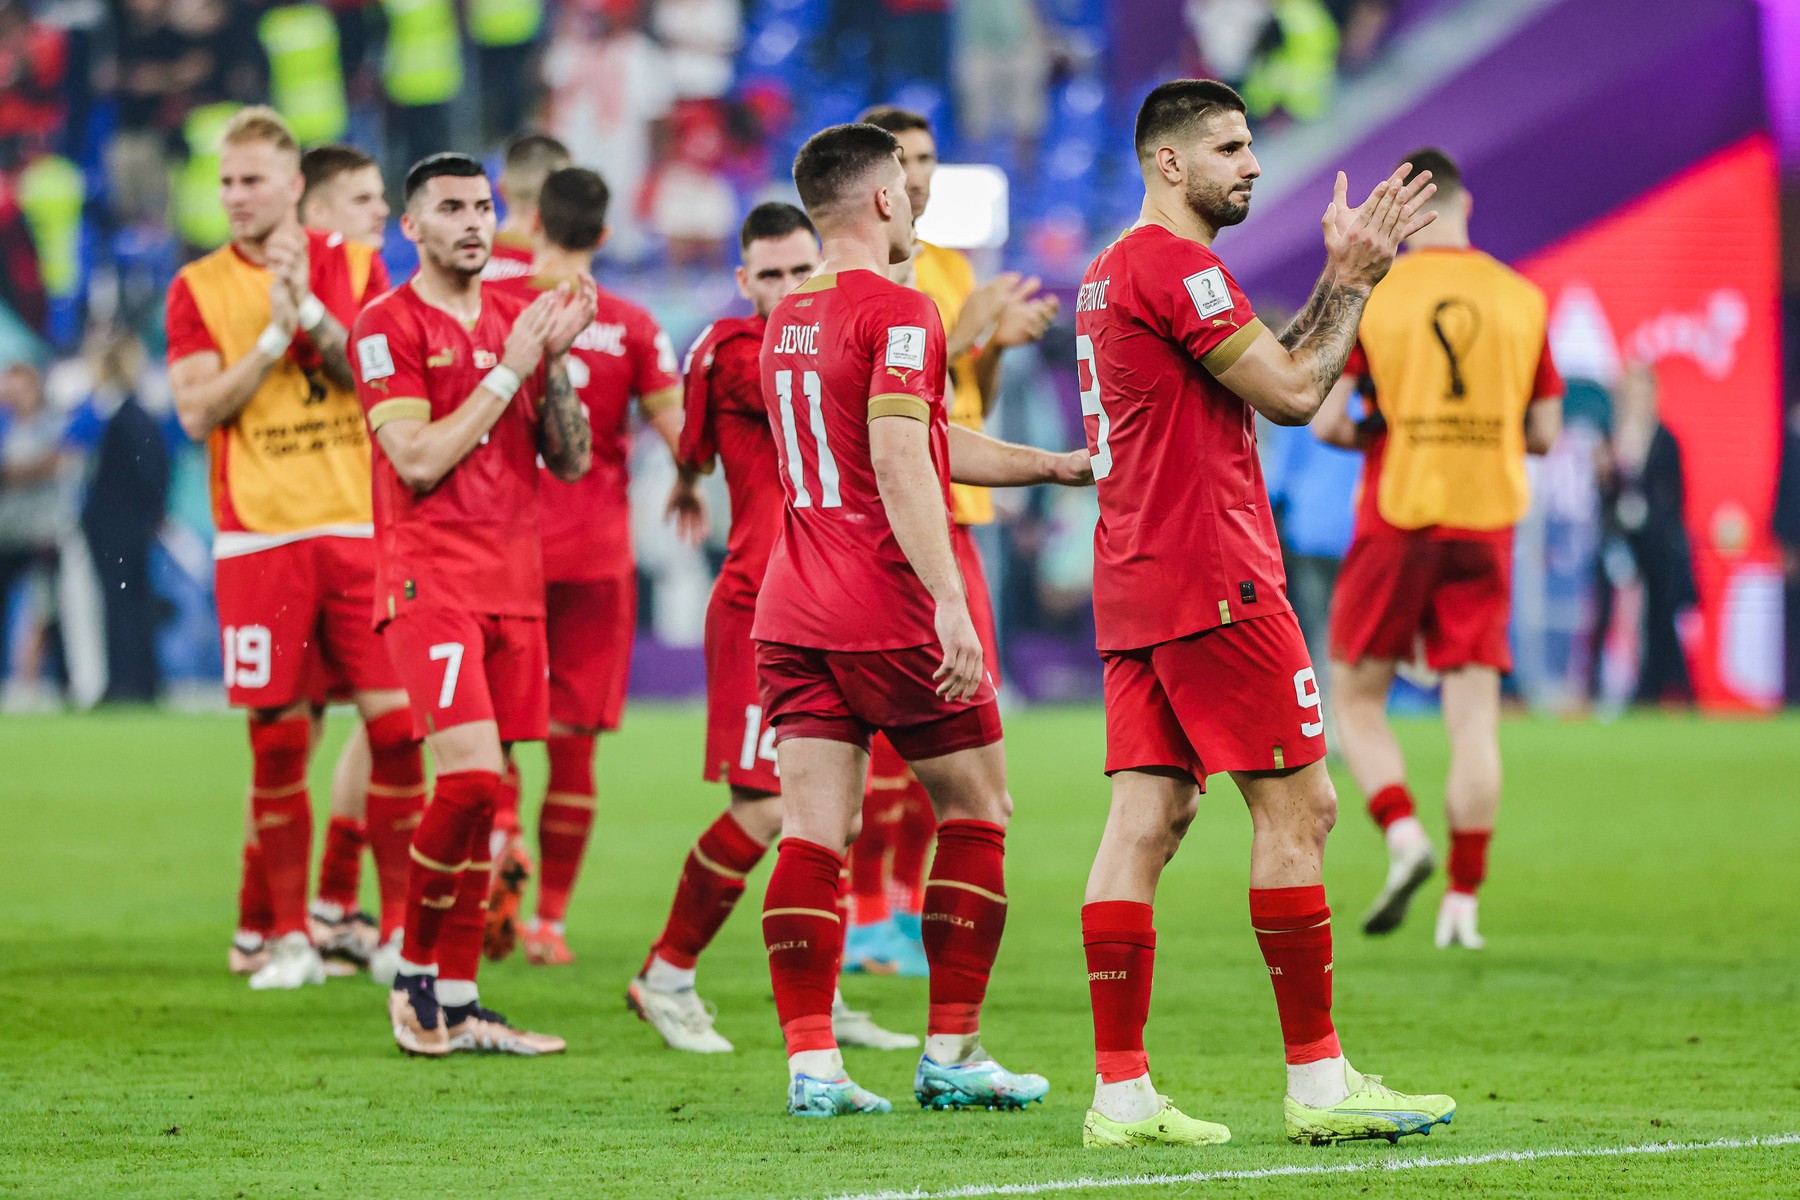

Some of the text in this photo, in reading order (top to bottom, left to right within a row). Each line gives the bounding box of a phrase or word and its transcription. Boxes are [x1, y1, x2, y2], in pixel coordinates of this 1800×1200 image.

[774, 322, 820, 355] JOVIĆ
[775, 370, 842, 508] 11
[224, 625, 272, 688] 19
[429, 642, 464, 708] 7
[1293, 666, 1324, 738] 9
[1125, 1129, 1157, 1143] ULTRA
